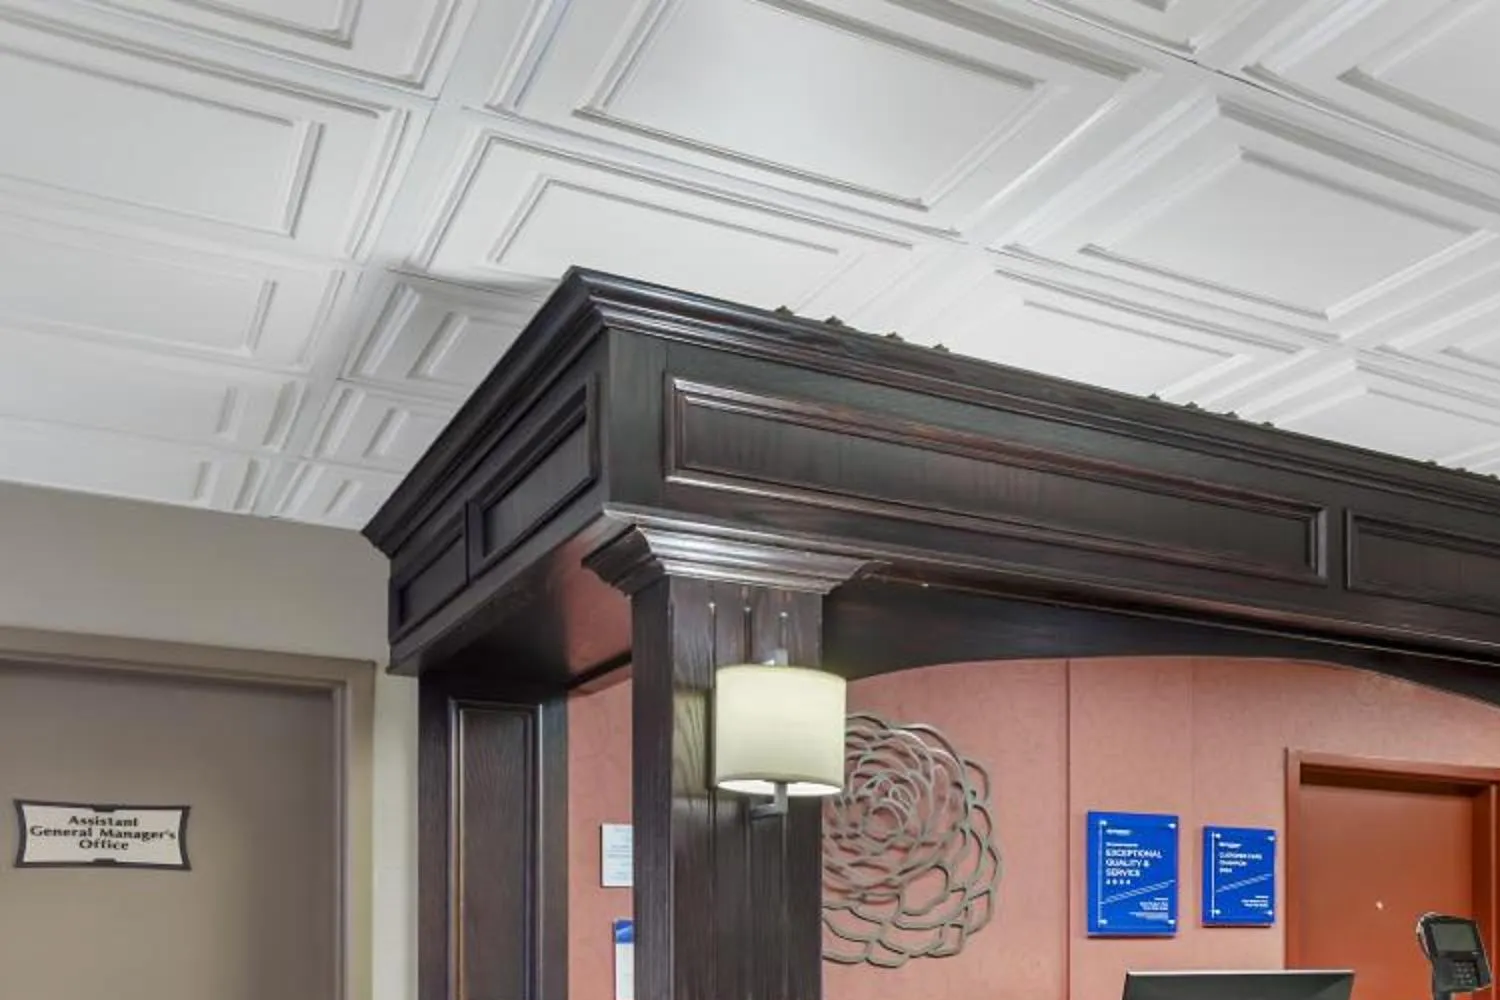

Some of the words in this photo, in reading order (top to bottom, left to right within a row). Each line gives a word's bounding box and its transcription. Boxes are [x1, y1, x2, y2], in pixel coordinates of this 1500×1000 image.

[68, 815, 139, 827] Assistant
[30, 826, 92, 837] General
[100, 828, 176, 841] Manager's
[79, 838, 129, 850] Office
[1105, 849, 1162, 858] EXCEPTIONAL
[1105, 859, 1142, 867] QUALITY
[1105, 869, 1140, 877] SERVICE
